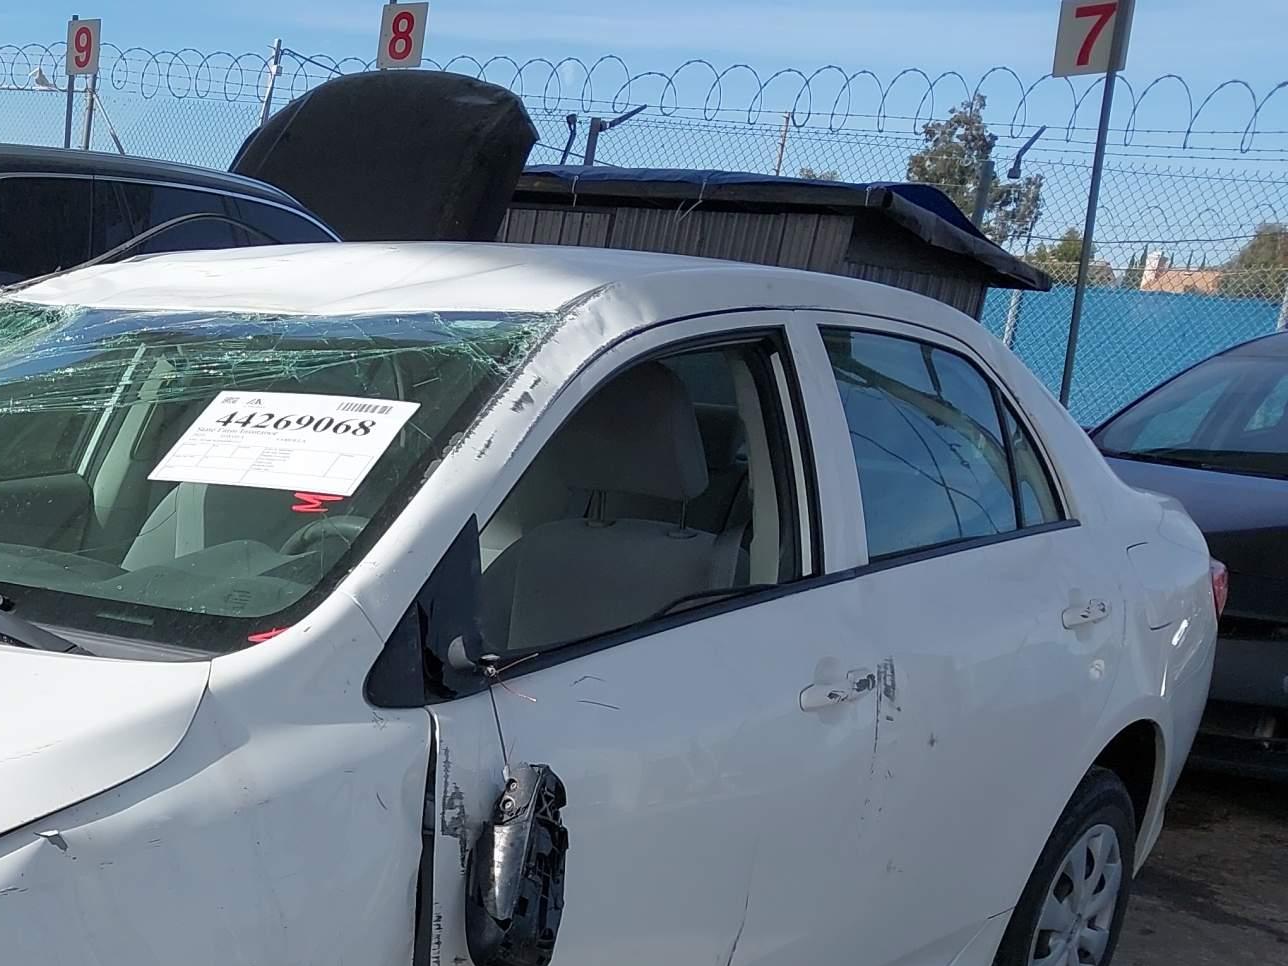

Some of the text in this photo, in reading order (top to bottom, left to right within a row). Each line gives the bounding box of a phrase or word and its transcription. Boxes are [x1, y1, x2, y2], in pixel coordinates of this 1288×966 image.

[74, 26, 92, 68] 9
[388, 11, 415, 60] 8
[1075, 2, 1118, 66] 7
[216, 411, 377, 436] 44269068
